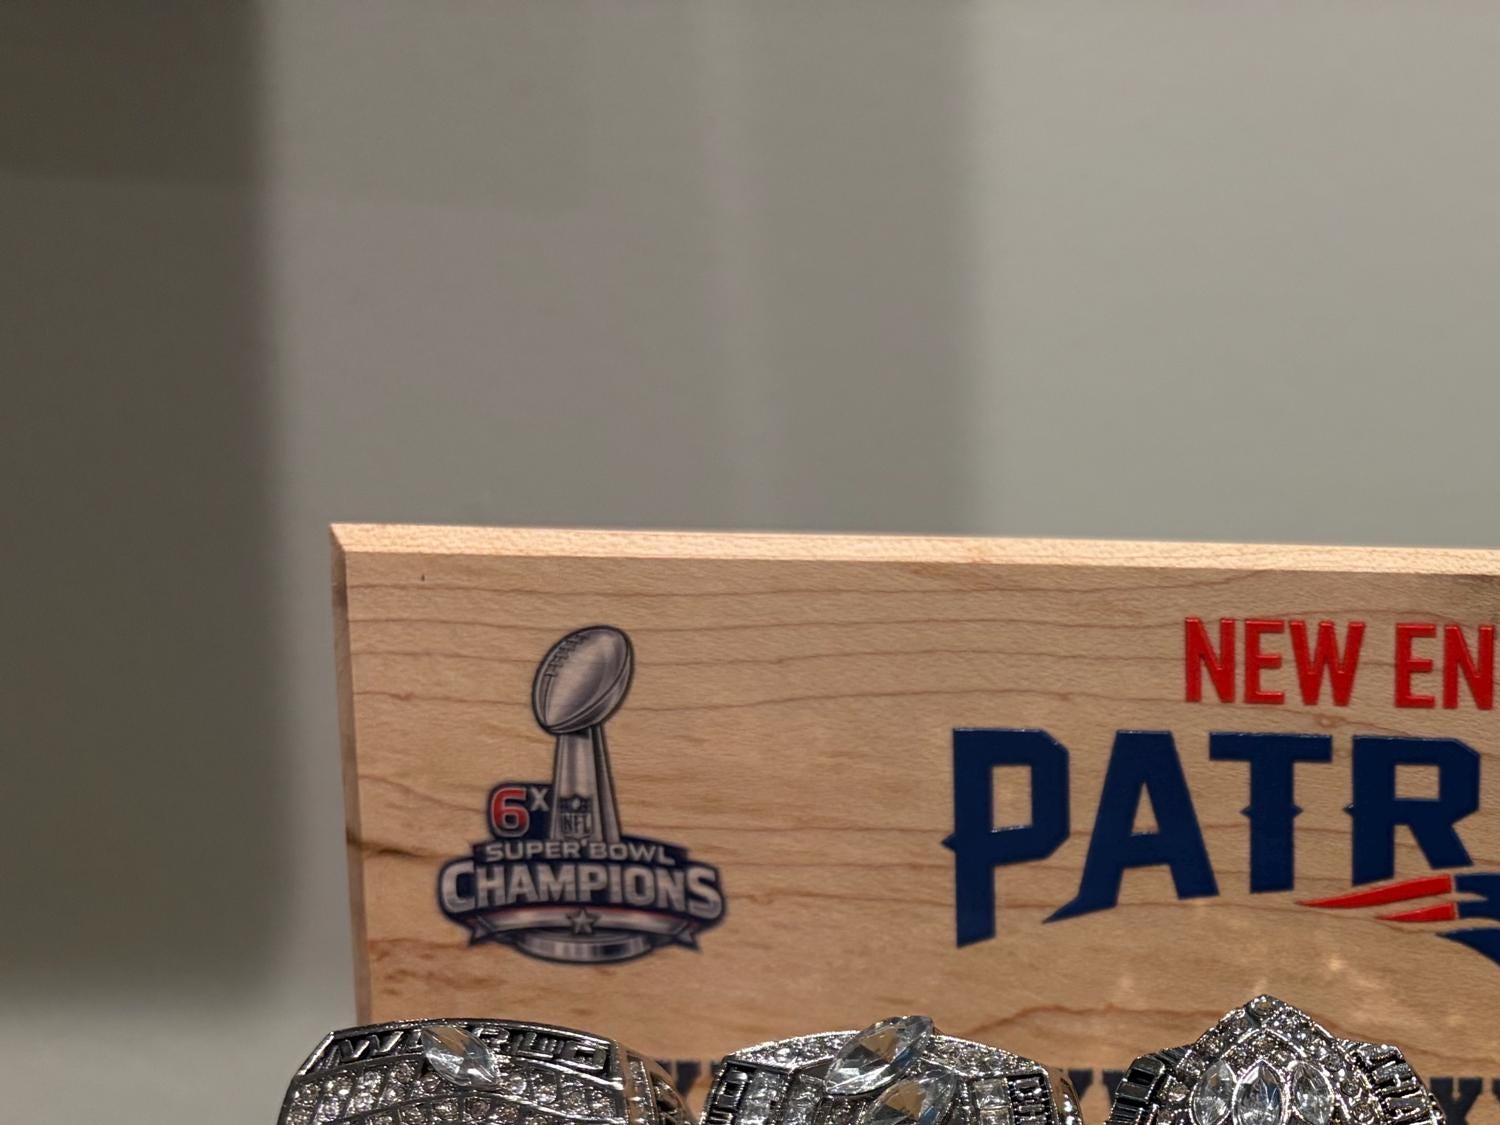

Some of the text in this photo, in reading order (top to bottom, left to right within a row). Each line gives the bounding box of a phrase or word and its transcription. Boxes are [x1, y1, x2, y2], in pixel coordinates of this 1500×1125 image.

[1185, 617, 1365, 706] NEW
[485, 841, 676, 865] SUPER BOWL
[441, 861, 723, 919] CHAMPIONS
